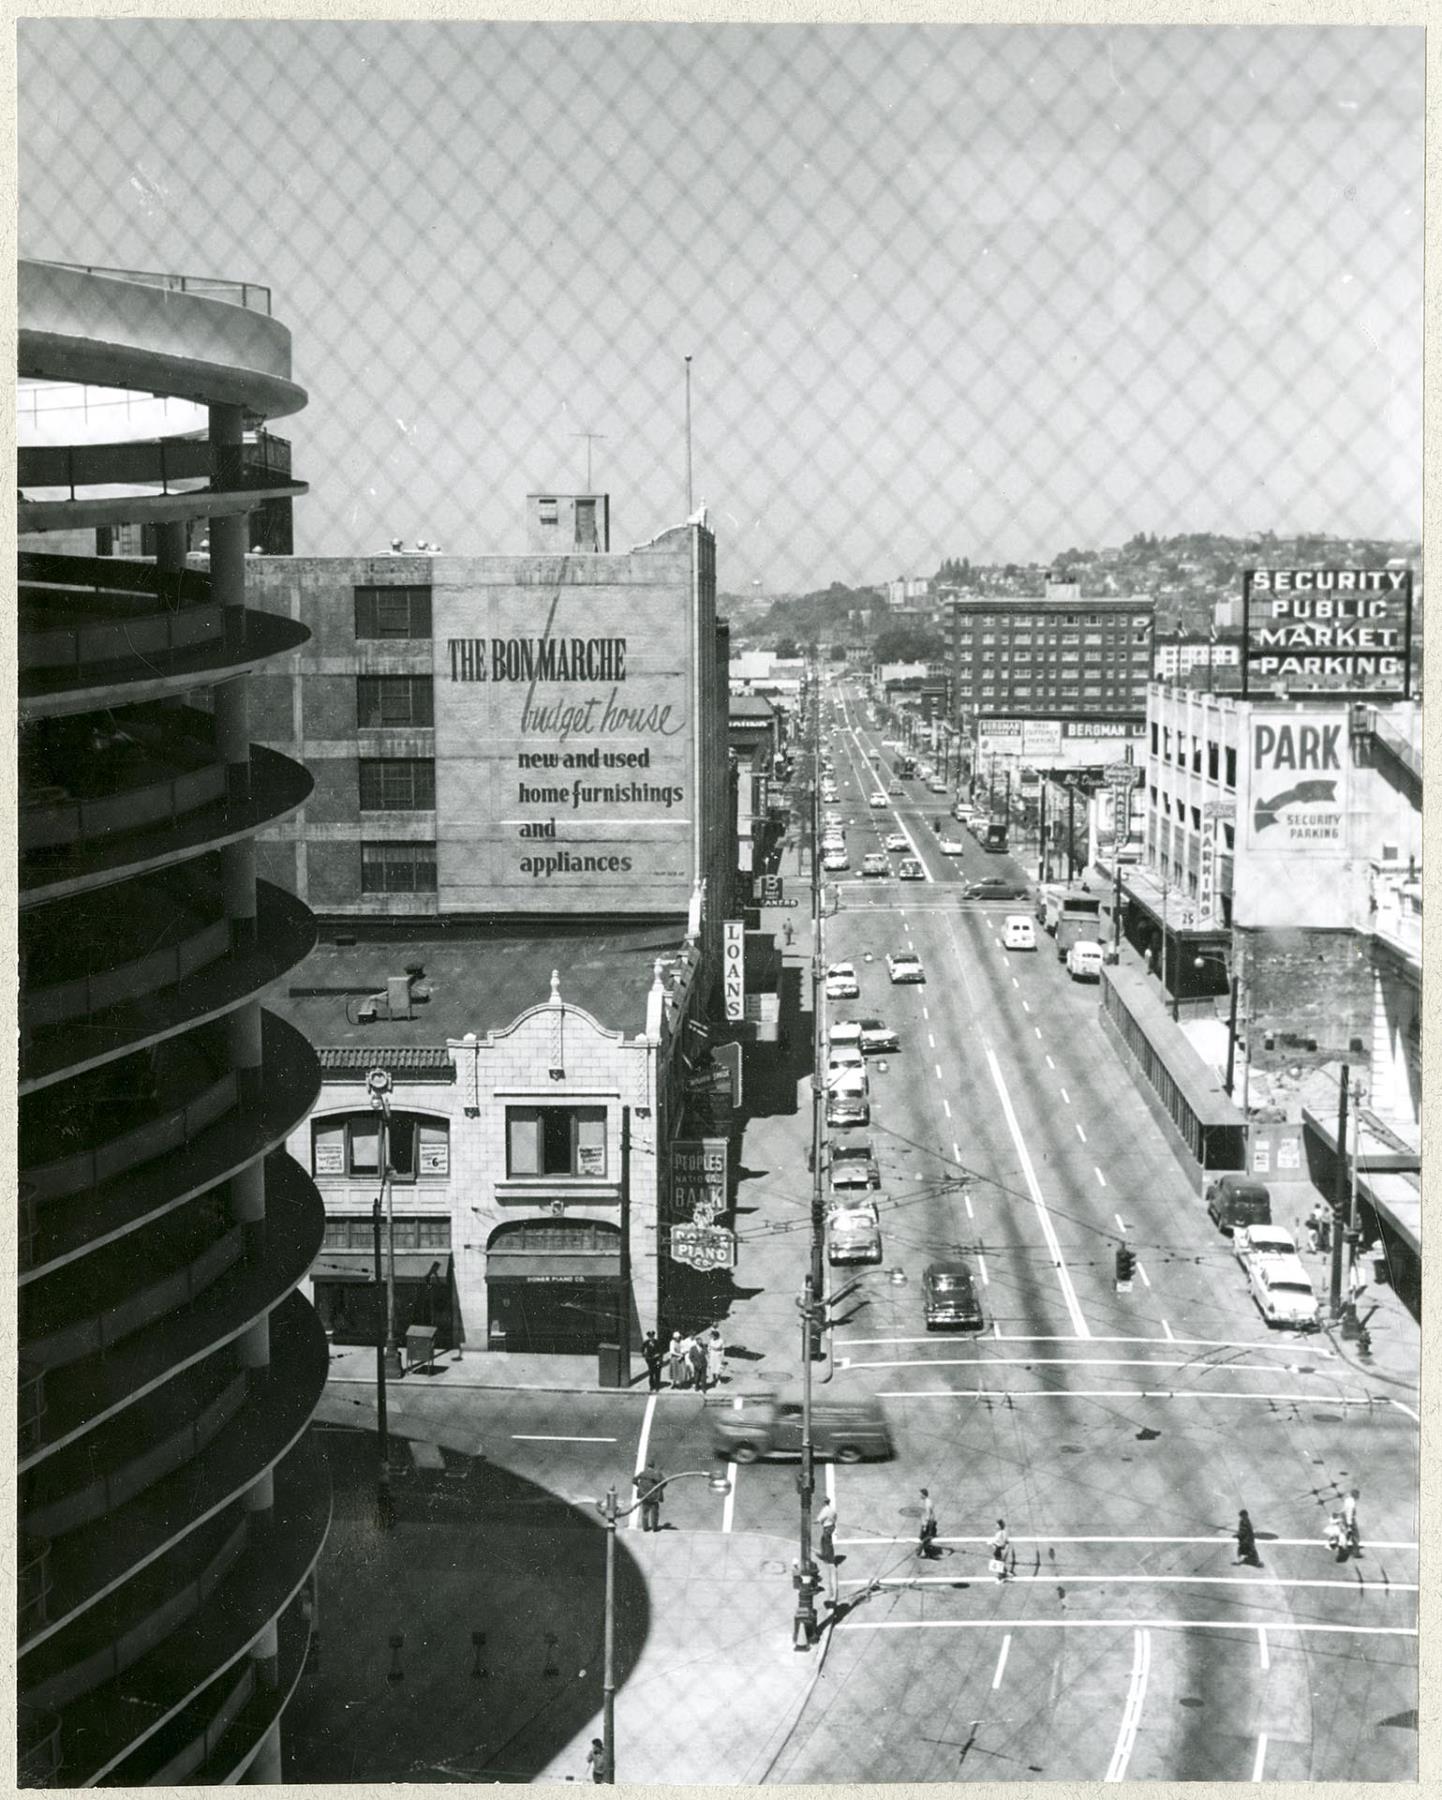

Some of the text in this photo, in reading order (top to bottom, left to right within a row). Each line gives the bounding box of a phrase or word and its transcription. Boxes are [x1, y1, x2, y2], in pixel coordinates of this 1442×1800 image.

[1254, 571, 1406, 590] SECURITY
[1272, 599, 1387, 618] PUBLIC
[1259, 628, 1398, 647] MARKET
[448, 638, 627, 682] THE BON MARCHE
[1260, 656, 1398, 675] PARKING
[600, 686, 686, 736] house
[1068, 723, 1125, 736] BERGMAN
[1255, 725, 1341, 770] PARK
[518, 748, 650, 768] new and used
[518, 780, 684, 808] home furnishings
[1116, 786, 1126, 840] MARKET
[1287, 815, 1342, 825] SECURITY
[519, 817, 556, 838] and
[1290, 828, 1339, 839] PARKING
[519, 851, 632, 877] appliances
[1200, 822, 1213, 916] PARKING
[727, 925, 741, 1017] LOANS
[675, 1154, 722, 1171] PEOPLES
[675, 1173, 722, 1184] NATIONAL
[676, 1186, 722, 1208] BANK
[679, 1244, 727, 1261] PIANO
